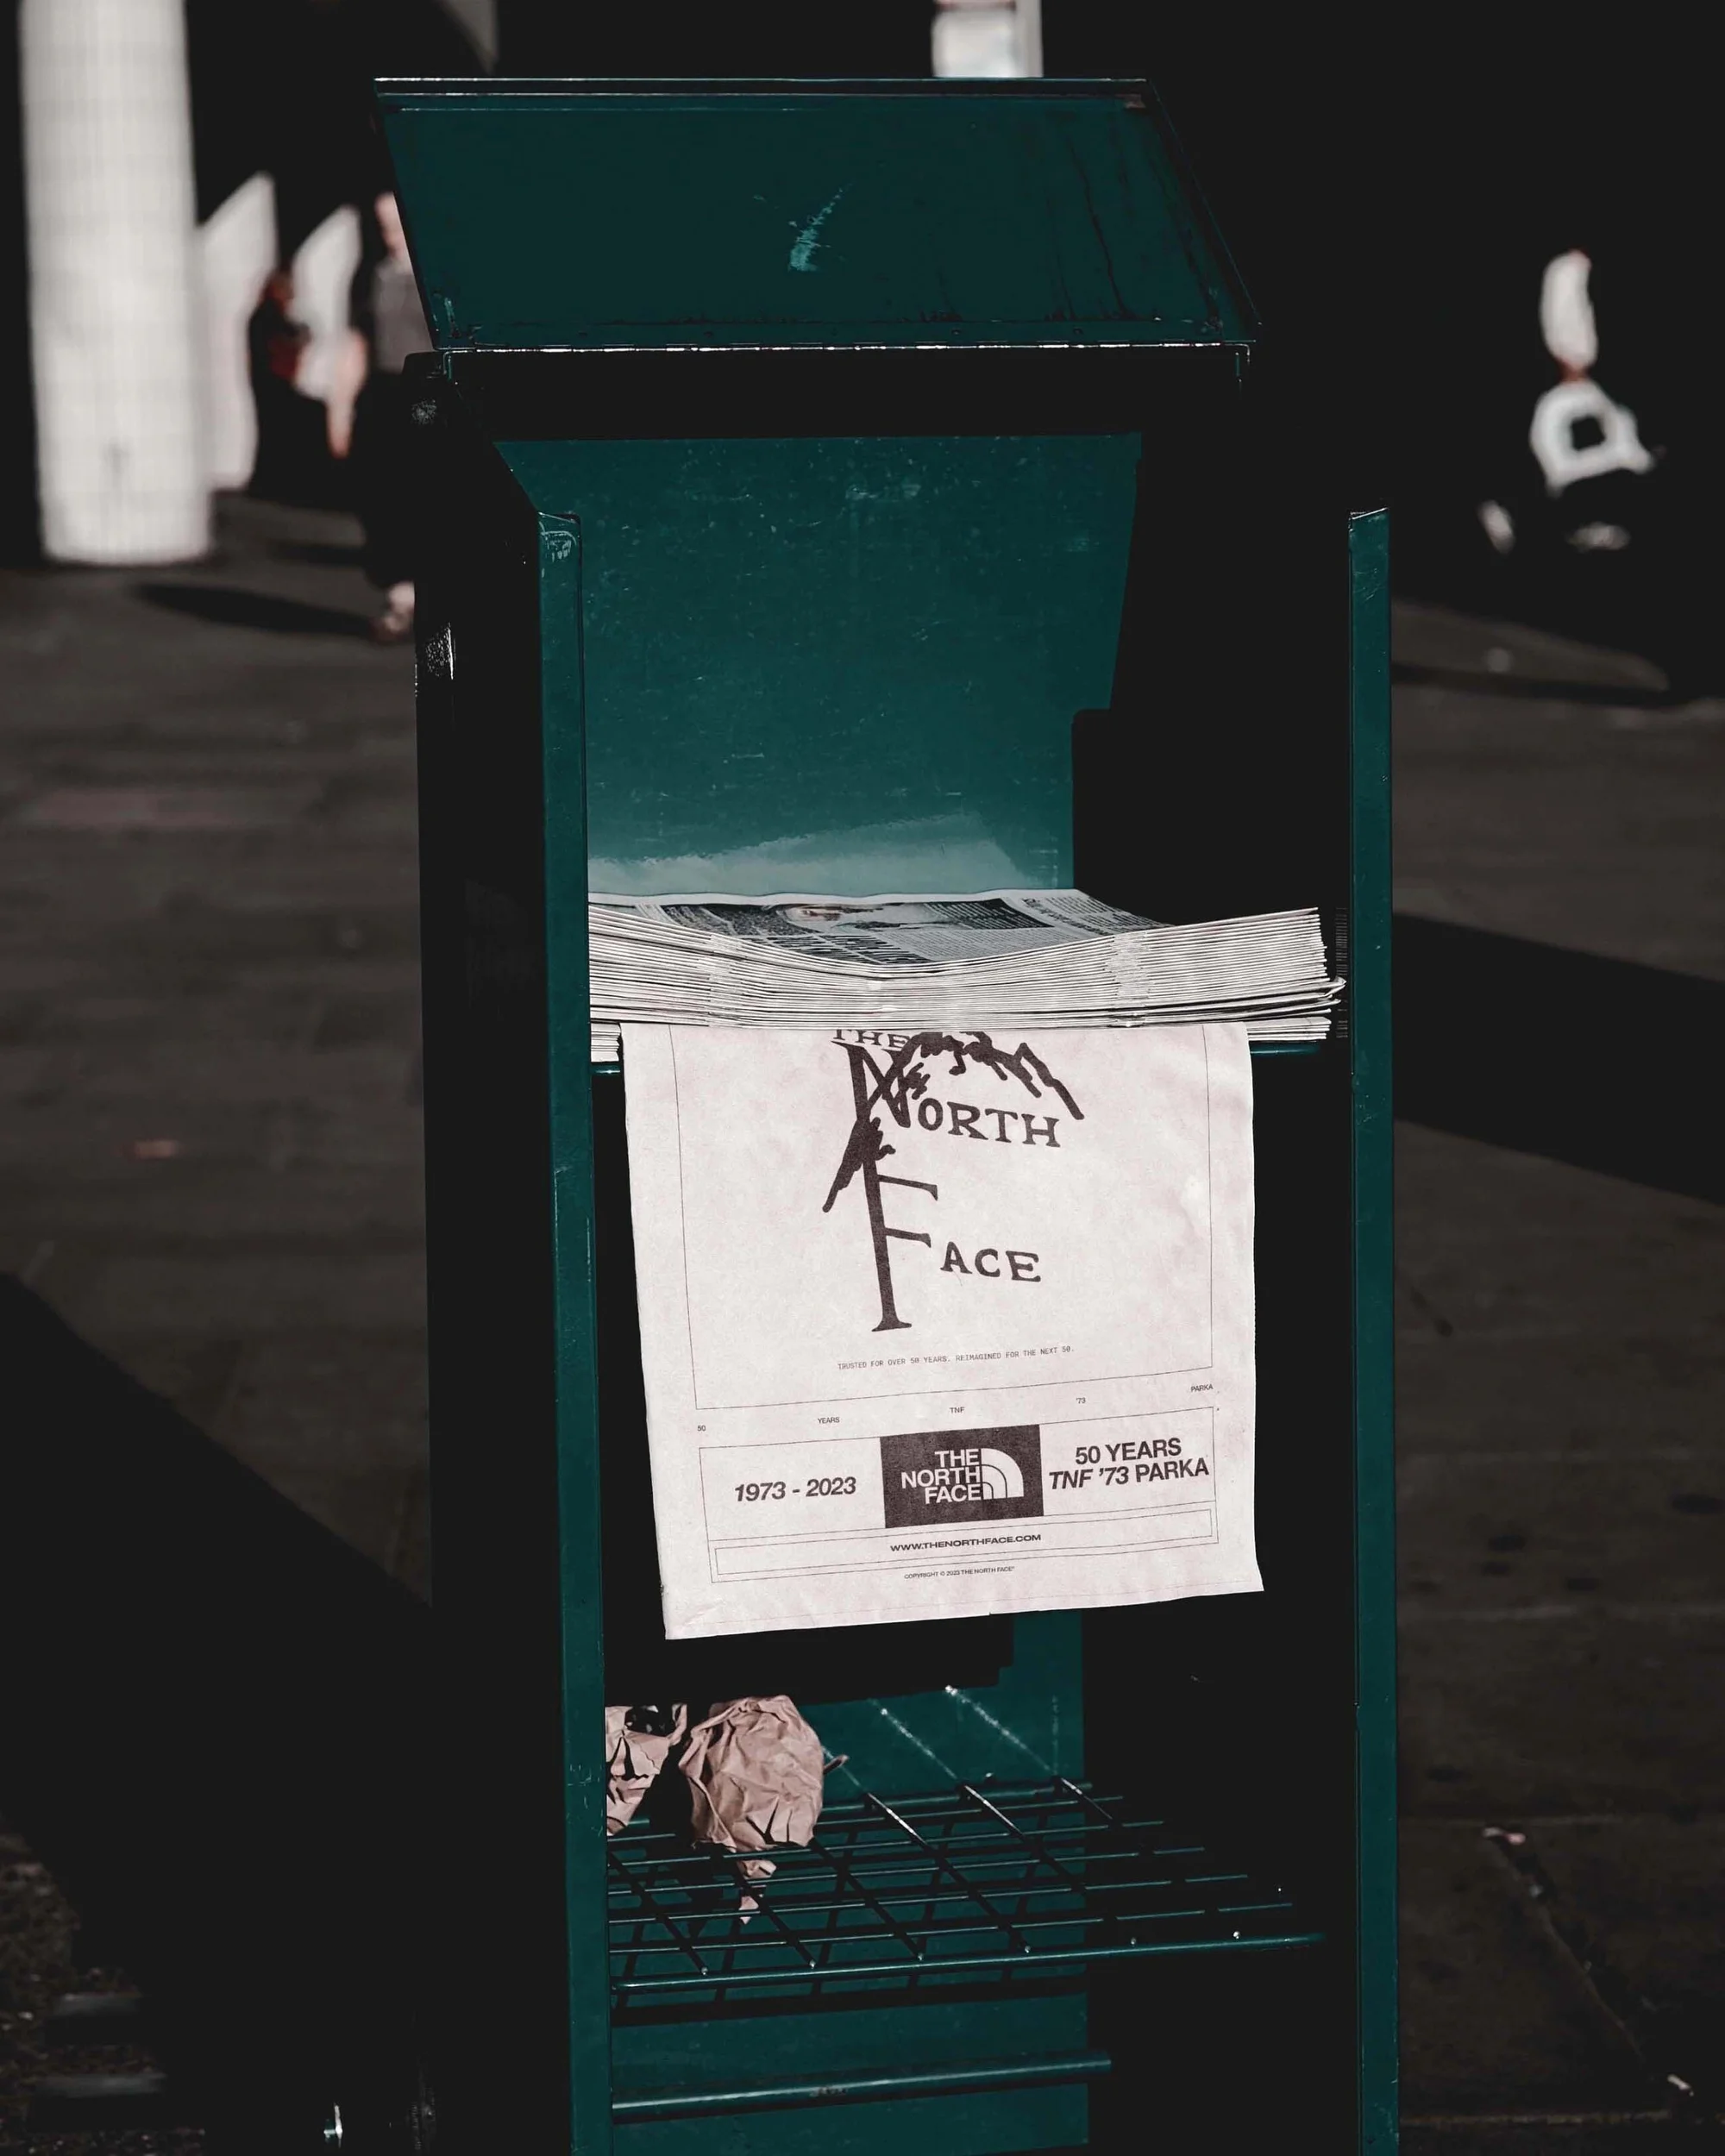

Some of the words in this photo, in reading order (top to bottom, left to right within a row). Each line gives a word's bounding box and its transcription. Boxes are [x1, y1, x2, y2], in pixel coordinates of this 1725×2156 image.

[831, 1040, 1061, 1148] NORTH
[862, 1159, 1042, 1332] FACE
[837, 1362, 867, 1370] TRUSTED
[956, 1352, 1001, 1362] REIMAGINED
[818, 1416, 840, 1425] YEARS
[1190, 1383, 1214, 1393] PARKA
[934, 1448, 980, 1468] THE
[1075, 1445, 1101, 1465] 50
[1105, 1437, 1182, 1463] YEARS
[900, 1465, 982, 1489] NORTH
[1048, 1468, 1094, 1490] TNF
[1136, 1457, 1210, 1483] PARKA
[734, 1481, 787, 1502] 1973
[806, 1476, 857, 1498] 2023
[925, 1483, 982, 1505] FACE
[890, 1534, 1042, 1552] WWW.THENORTHFACE.COM
[904, 1571, 938, 1580] COPYRIGHT
